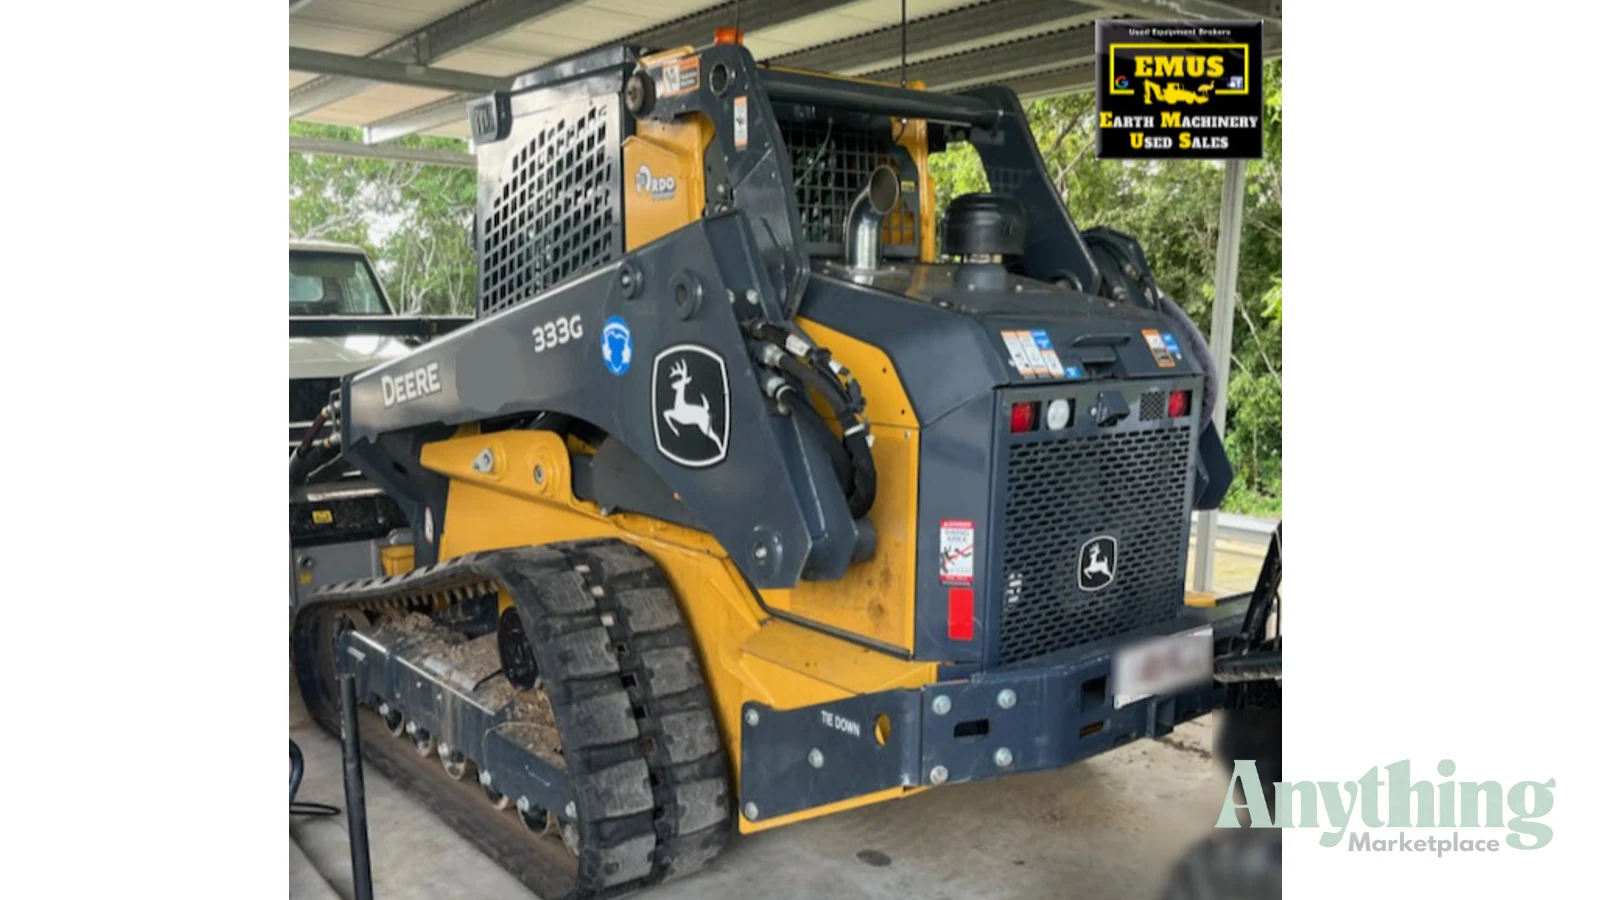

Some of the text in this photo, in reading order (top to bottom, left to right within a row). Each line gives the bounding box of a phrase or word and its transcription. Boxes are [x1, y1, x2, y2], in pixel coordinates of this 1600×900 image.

[532, 314, 584, 353] 333G
[381, 362, 441, 407] DEERE
[821, 709, 860, 737] TIE DOWN
